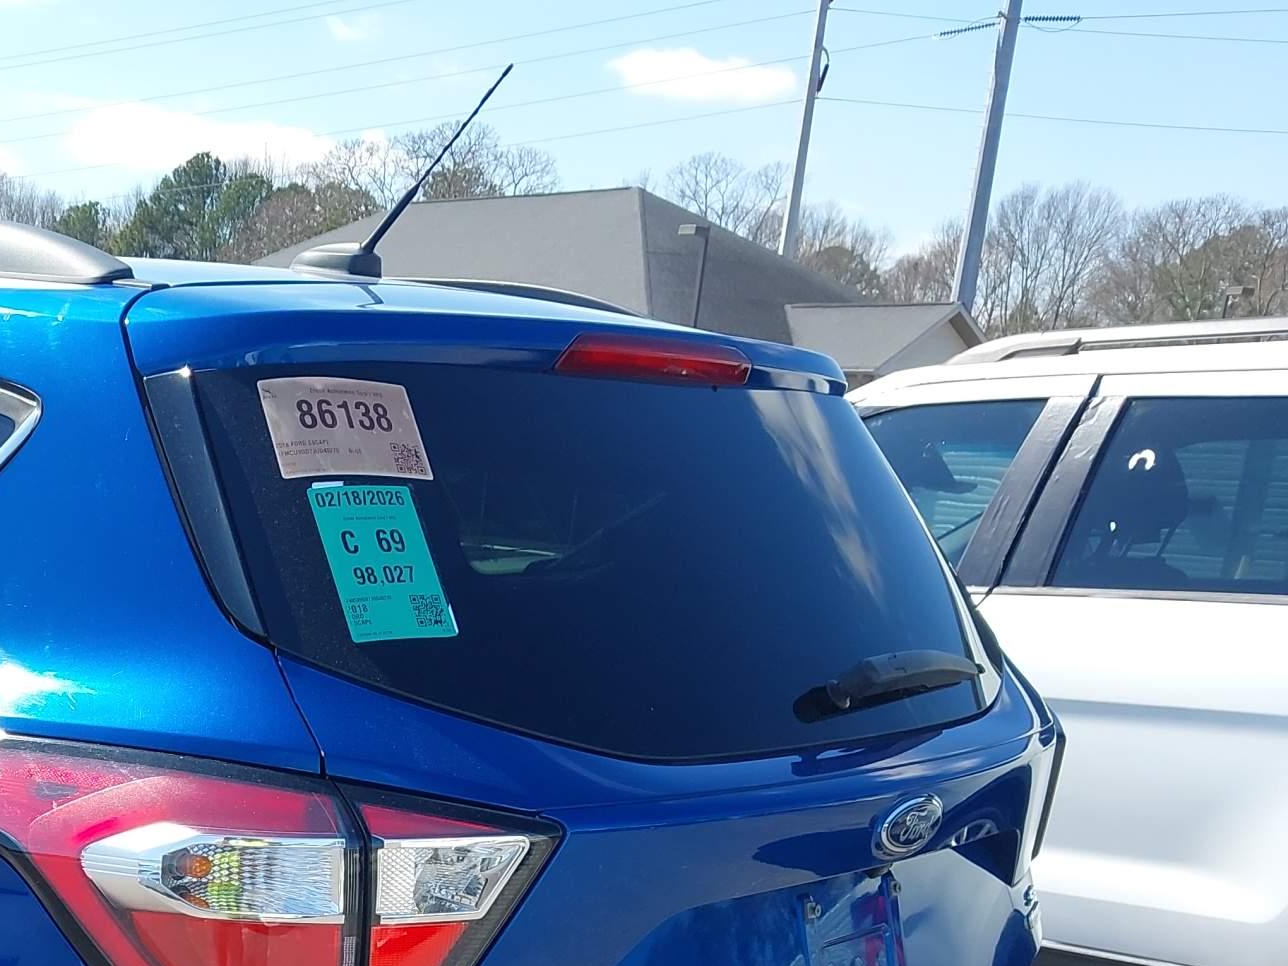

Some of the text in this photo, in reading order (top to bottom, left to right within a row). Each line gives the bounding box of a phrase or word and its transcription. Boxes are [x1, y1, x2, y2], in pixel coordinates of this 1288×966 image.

[296, 399, 393, 432] 86138
[314, 490, 405, 508] 02/18/2026
[340, 528, 406, 554] C 69
[353, 565, 414, 586] 98,027
